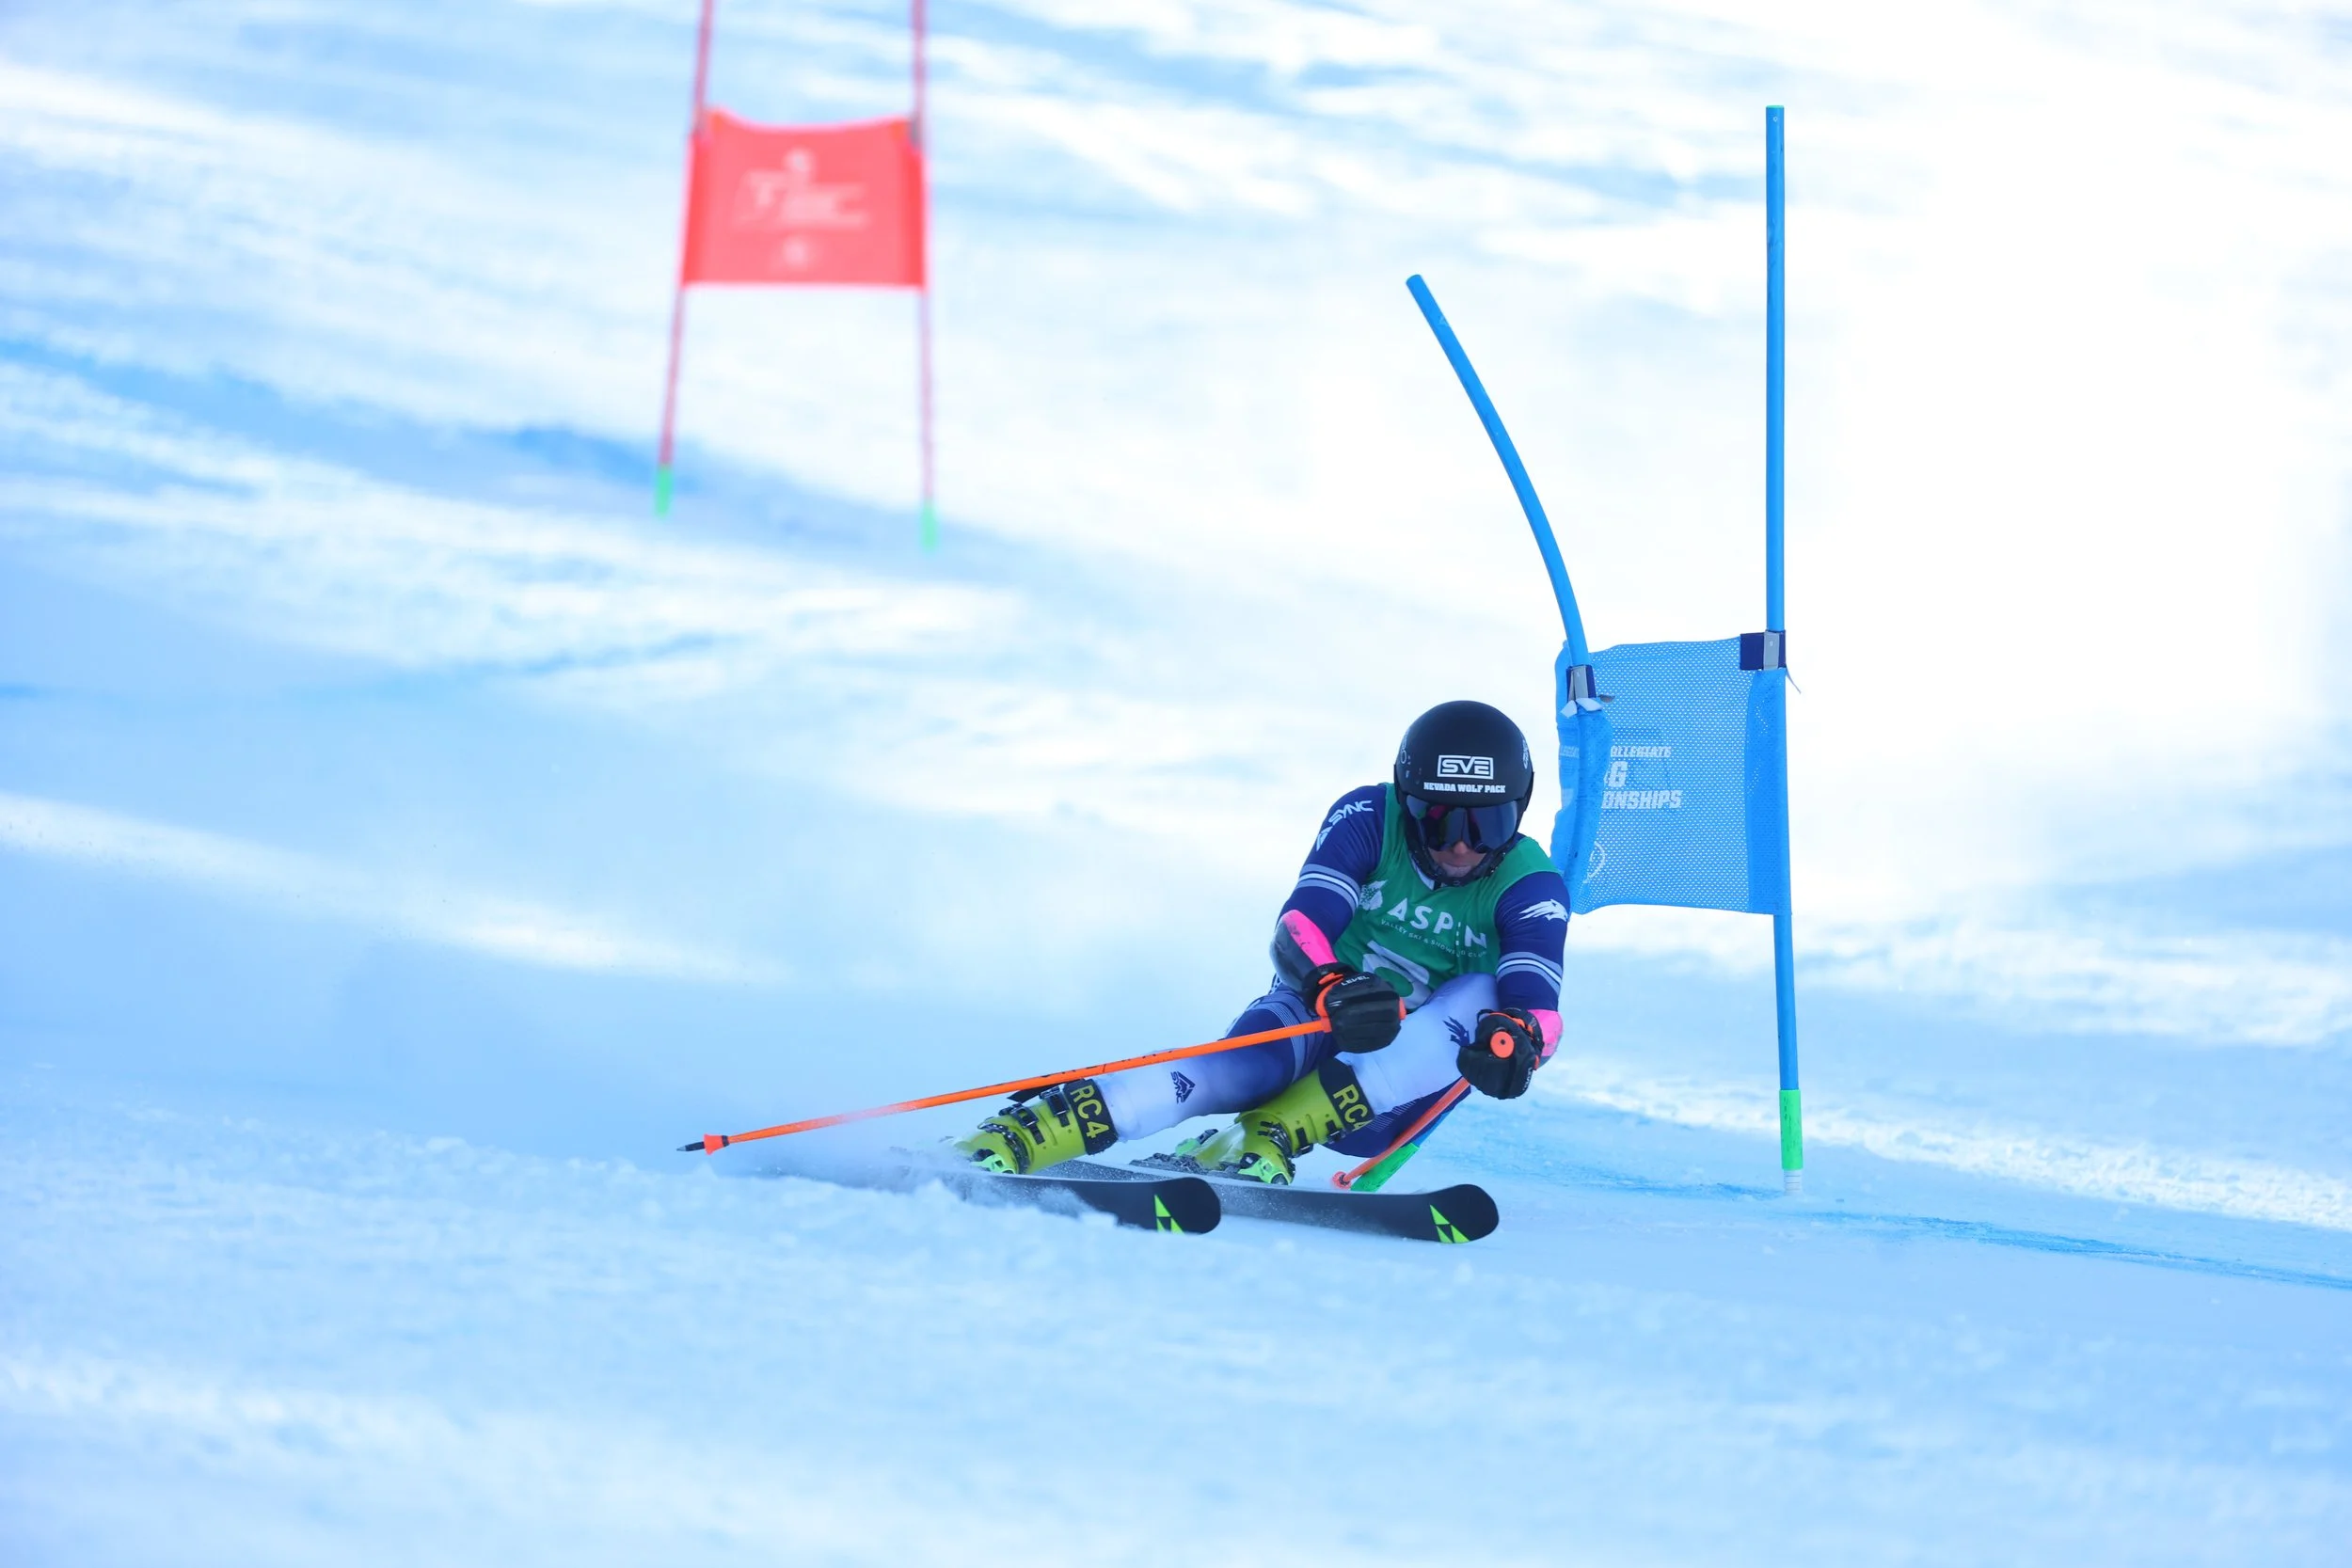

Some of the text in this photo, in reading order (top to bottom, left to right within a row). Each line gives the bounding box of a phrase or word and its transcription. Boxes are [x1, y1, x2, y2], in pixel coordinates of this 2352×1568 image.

[1441, 756, 1490, 775] SVE
[1423, 782, 1506, 794] NEVADA WOLF PACK
[1327, 800, 1375, 826] SYNC
[1381, 918, 1407, 935] VALLEY
[1408, 932, 1422, 941] SKI
[1341, 975, 1370, 986] LEVEL
[1070, 1085, 1110, 1139] RC4
